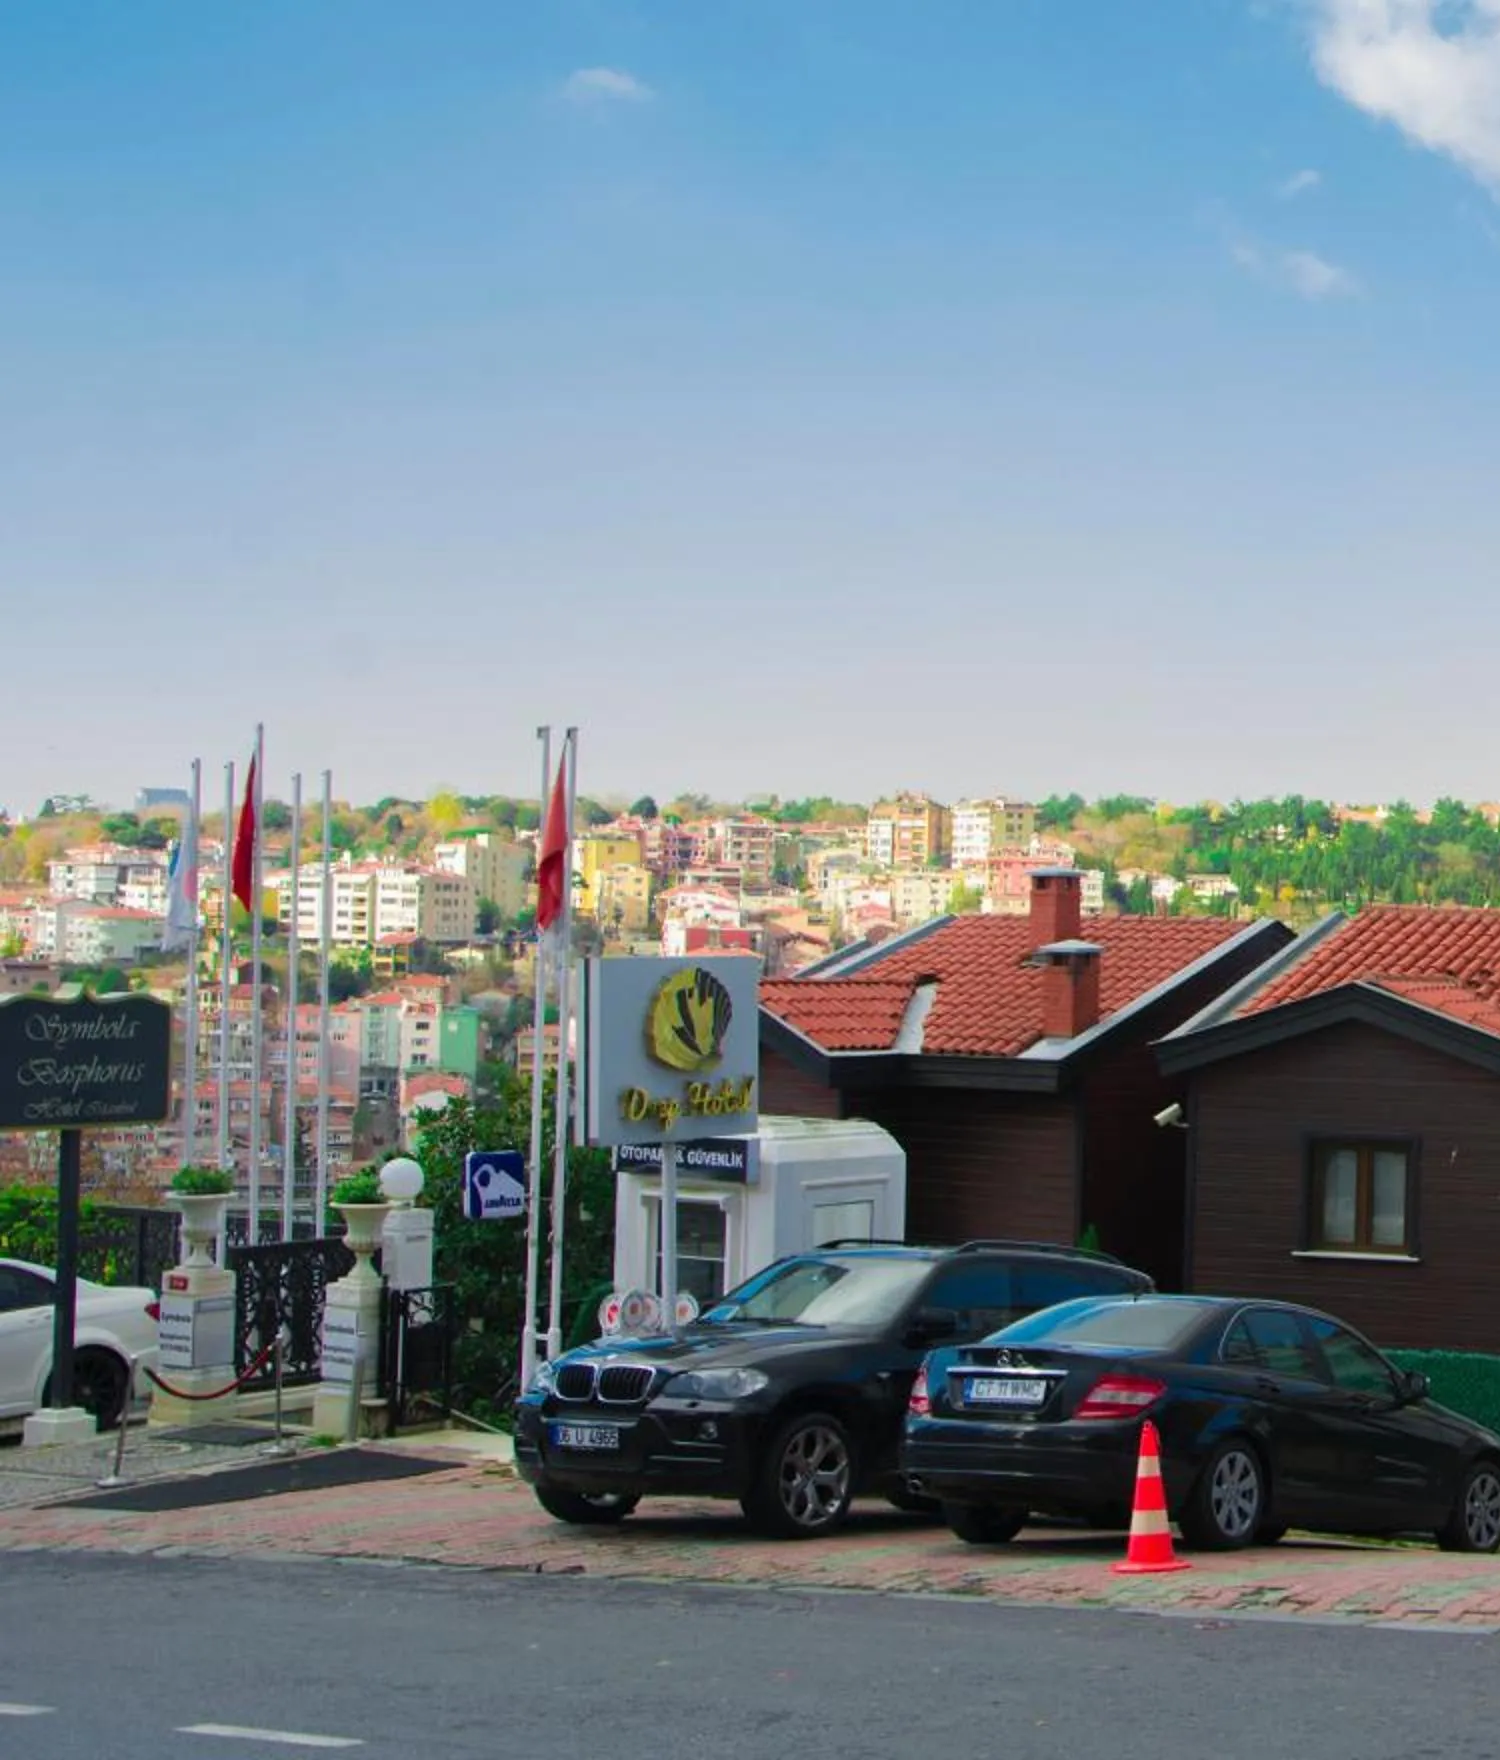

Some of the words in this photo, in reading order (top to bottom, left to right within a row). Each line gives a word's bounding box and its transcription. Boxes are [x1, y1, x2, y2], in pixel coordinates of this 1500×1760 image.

[24, 1011, 142, 1050] Symbola
[17, 1054, 145, 1095] Bosphorus
[686, 1075, 755, 1117] Hotel
[620, 1145, 664, 1161] OTOPAR
[687, 1149, 744, 1168] GÜVENLİK
